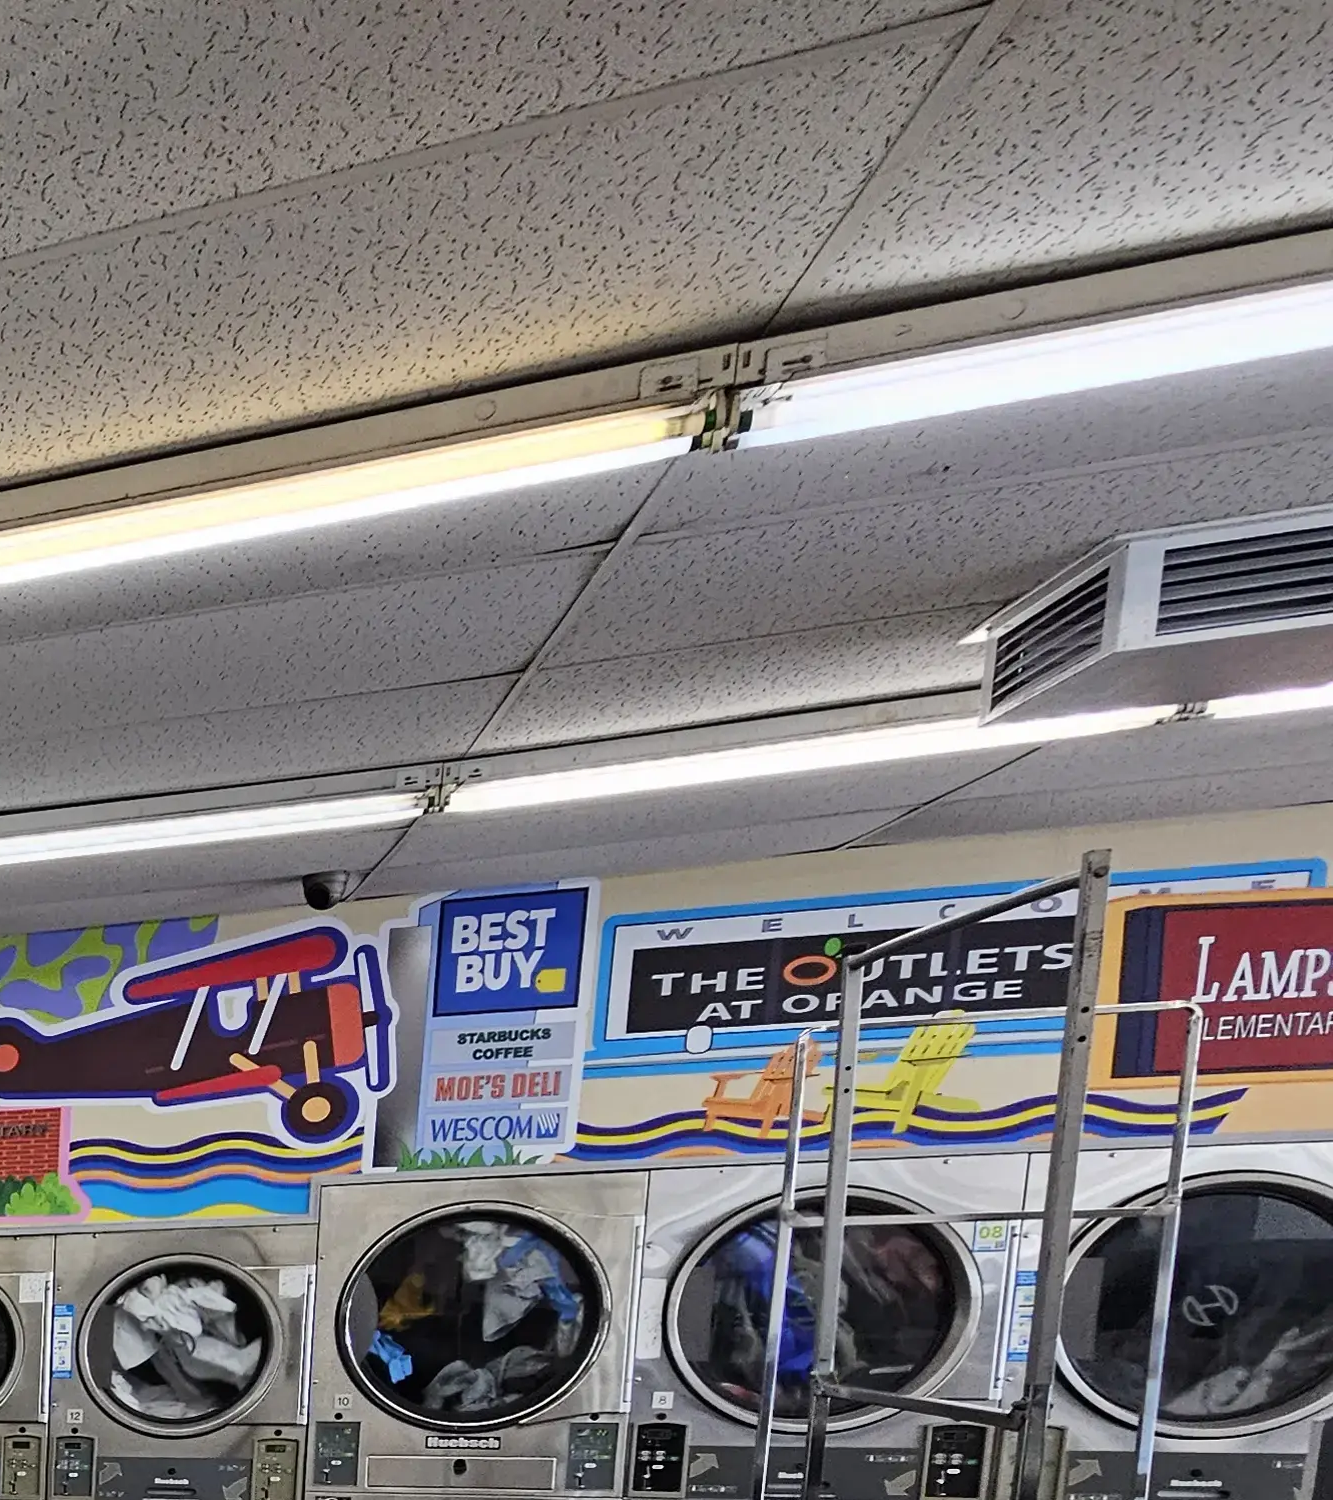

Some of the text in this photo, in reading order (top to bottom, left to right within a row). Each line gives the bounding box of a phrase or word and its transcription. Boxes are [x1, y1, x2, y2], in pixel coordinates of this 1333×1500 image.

[451, 908, 556, 953] BEST
[455, 950, 545, 994] BUY
[1191, 936, 1333, 1003] LAMP
[651, 967, 765, 998] THE
[696, 1000, 763, 1022] AT
[457, 1028, 552, 1045] STARBUCKS
[1201, 1010, 1333, 1041] LEMENTA
[473, 1046, 534, 1060] COFFEE
[435, 1071, 563, 1102] MOE'S DELI
[430, 1115, 533, 1142] WESCOM
[979, 1225, 1003, 1240] 08
[337, 1397, 350, 1407] 10
[658, 1395, 667, 1405] 8
[70, 1411, 81, 1420] 12
